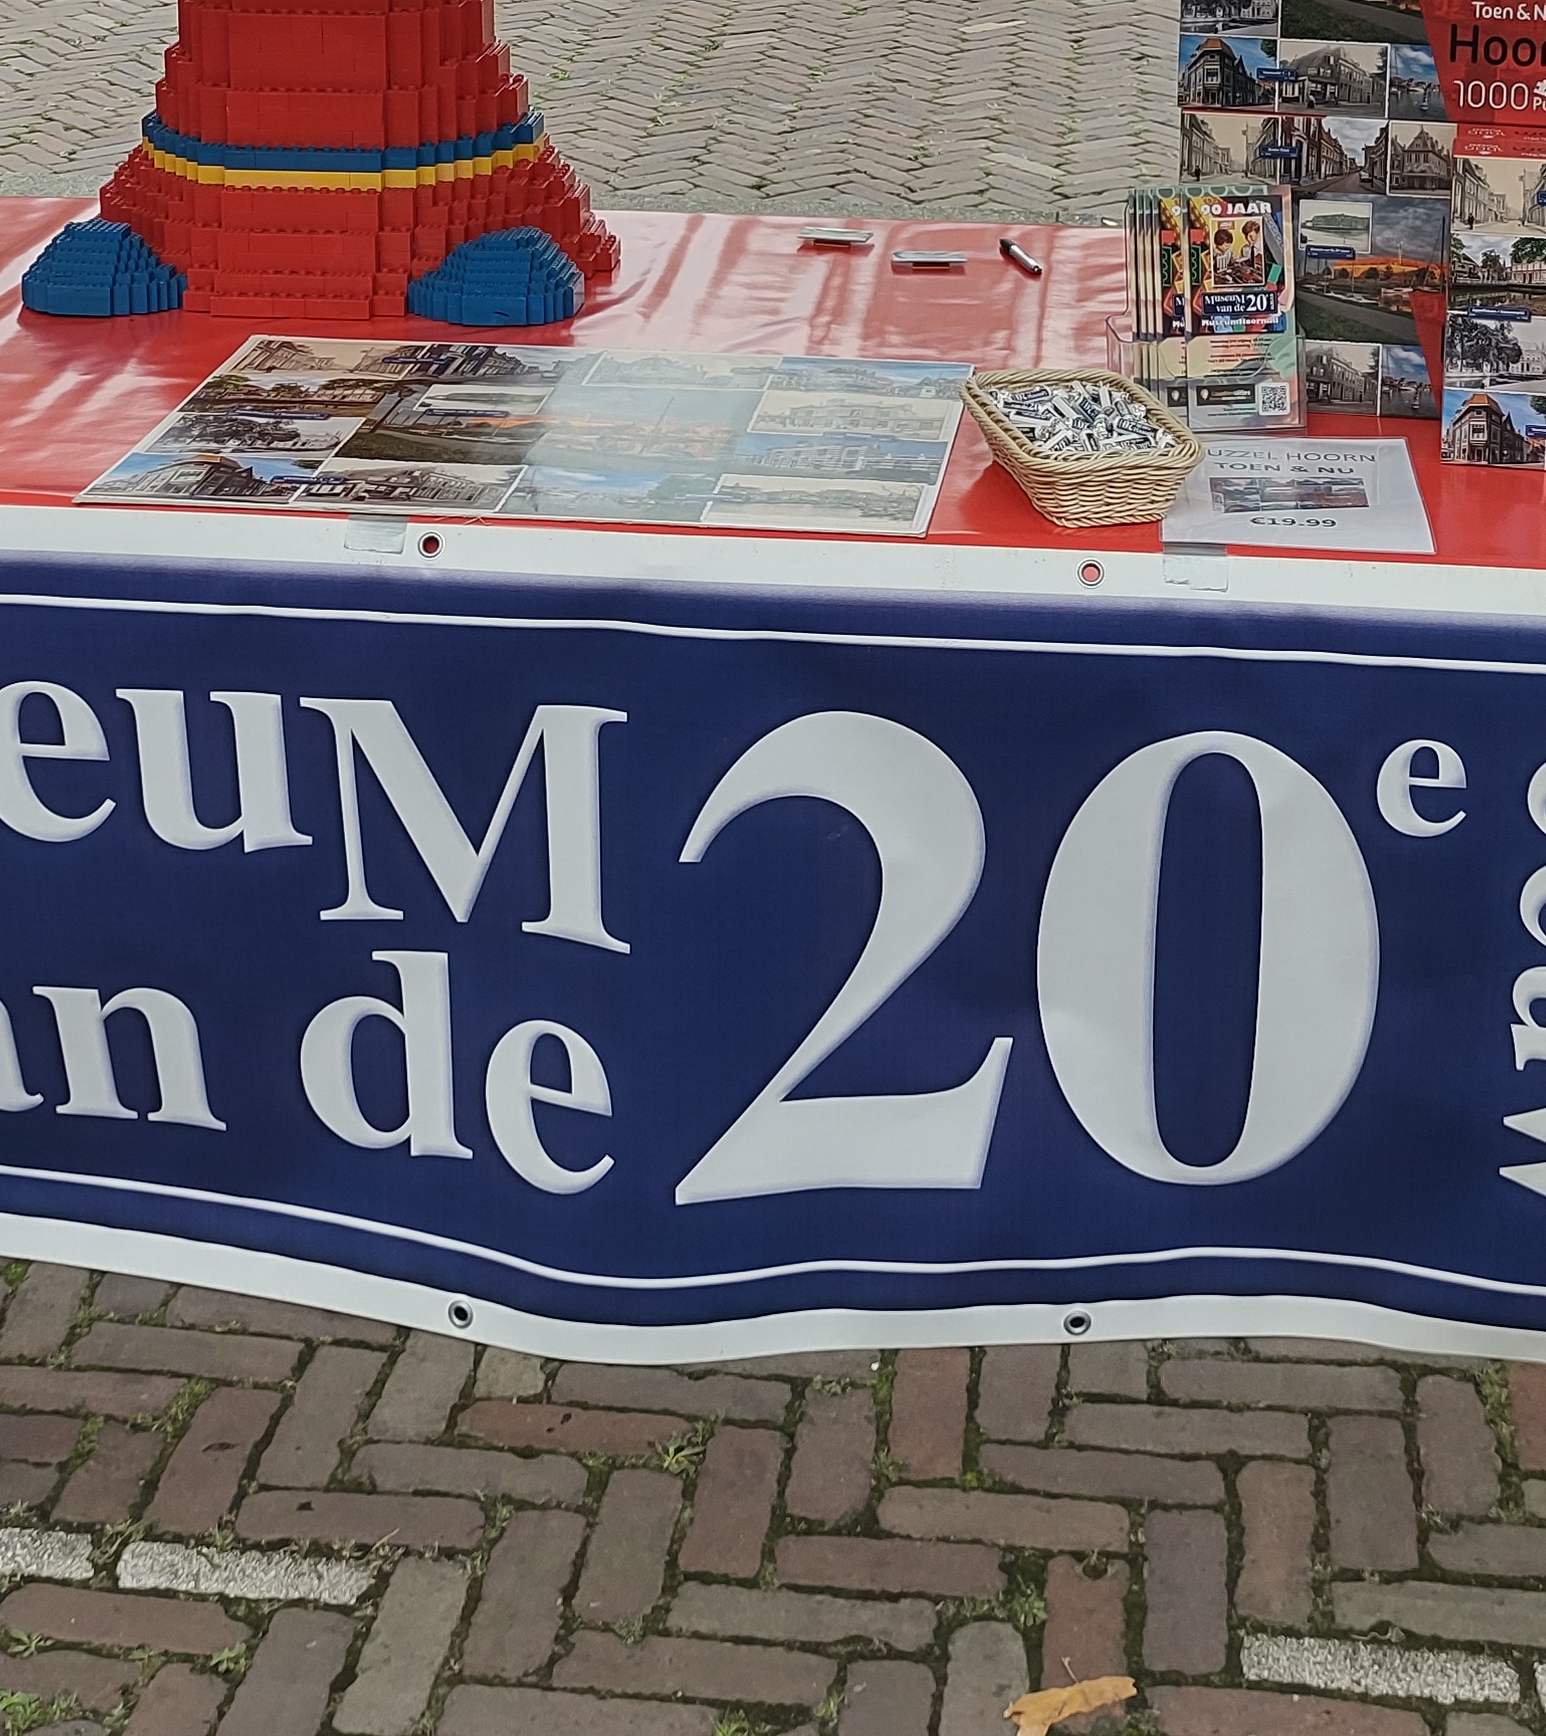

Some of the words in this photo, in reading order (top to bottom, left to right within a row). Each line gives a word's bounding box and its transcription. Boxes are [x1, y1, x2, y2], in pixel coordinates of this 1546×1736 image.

[1471, 1, 1515, 20] Toen
[1518, 2, 1532, 20] &
[1453, 79, 1530, 110] 1000
[1200, 203, 1222, 215] 90
[1226, 202, 1272, 215] JAAR
[1207, 448, 1278, 461] UZZEL
[1286, 452, 1376, 462] HOORN
[1215, 462, 1280, 472] TOEN
[1250, 516, 1337, 527] €19.99
[676, 707, 1383, 1206] 20
[1378, 734, 1469, 840] e
[298, 945, 619, 1196] de
